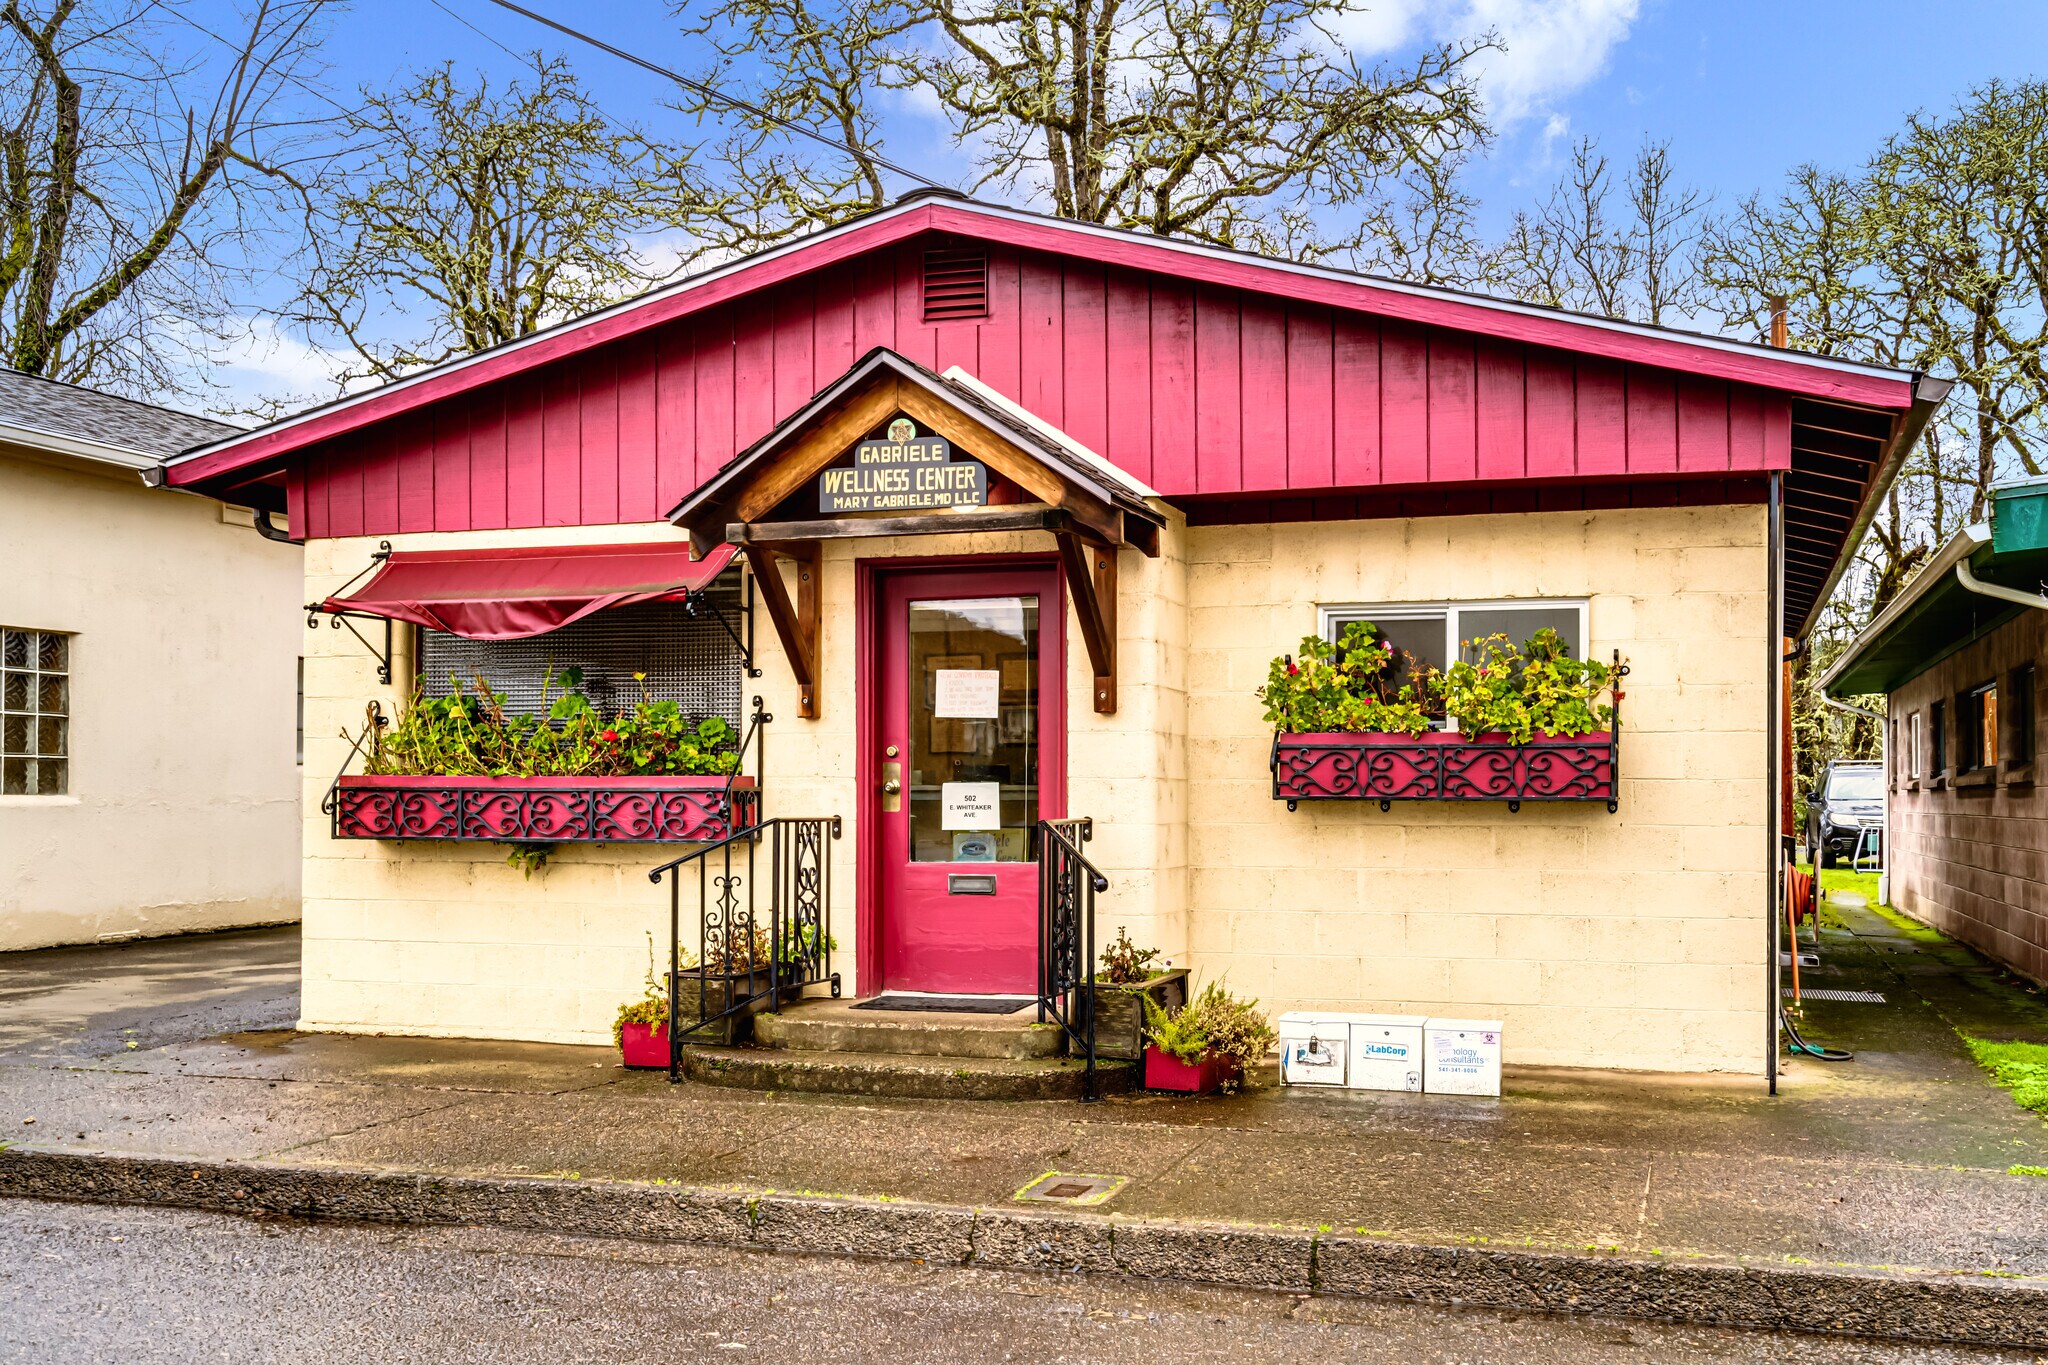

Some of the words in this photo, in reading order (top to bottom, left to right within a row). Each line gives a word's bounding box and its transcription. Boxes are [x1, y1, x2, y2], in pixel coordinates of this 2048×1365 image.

[860, 444, 943, 464] GABRIELE
[824, 468, 910, 494] WELLNESS
[916, 465, 976, 491] CENTER
[833, 496, 869, 509] MARY
[954, 491, 980, 504] LLC
[1371, 1045, 1407, 1057] LabCorp
